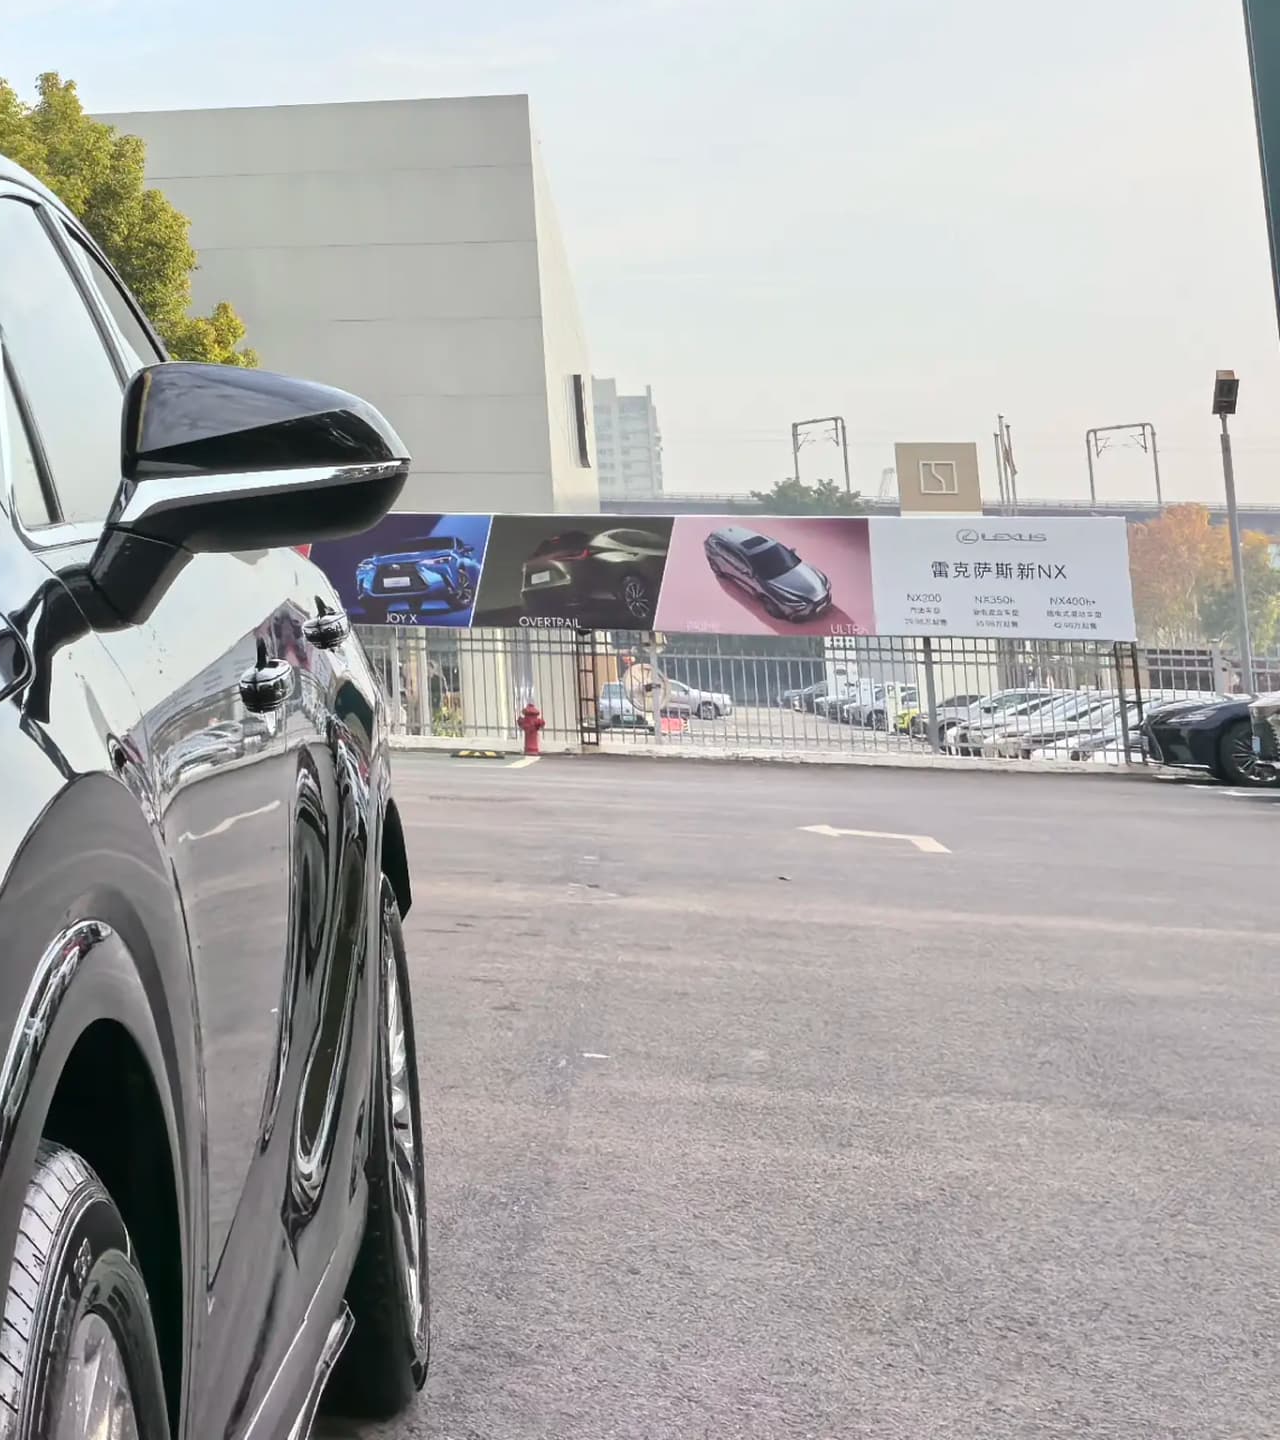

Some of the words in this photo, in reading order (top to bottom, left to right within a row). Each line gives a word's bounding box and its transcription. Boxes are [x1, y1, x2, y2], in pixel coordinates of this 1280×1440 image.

[980, 533, 1047, 542] LEXUS
[931, 561, 1068, 580] 雷克萨斯新NX
[385, 613, 407, 624] JOY
[409, 614, 418, 624] X
[519, 616, 582, 628] OVERTRAIL
